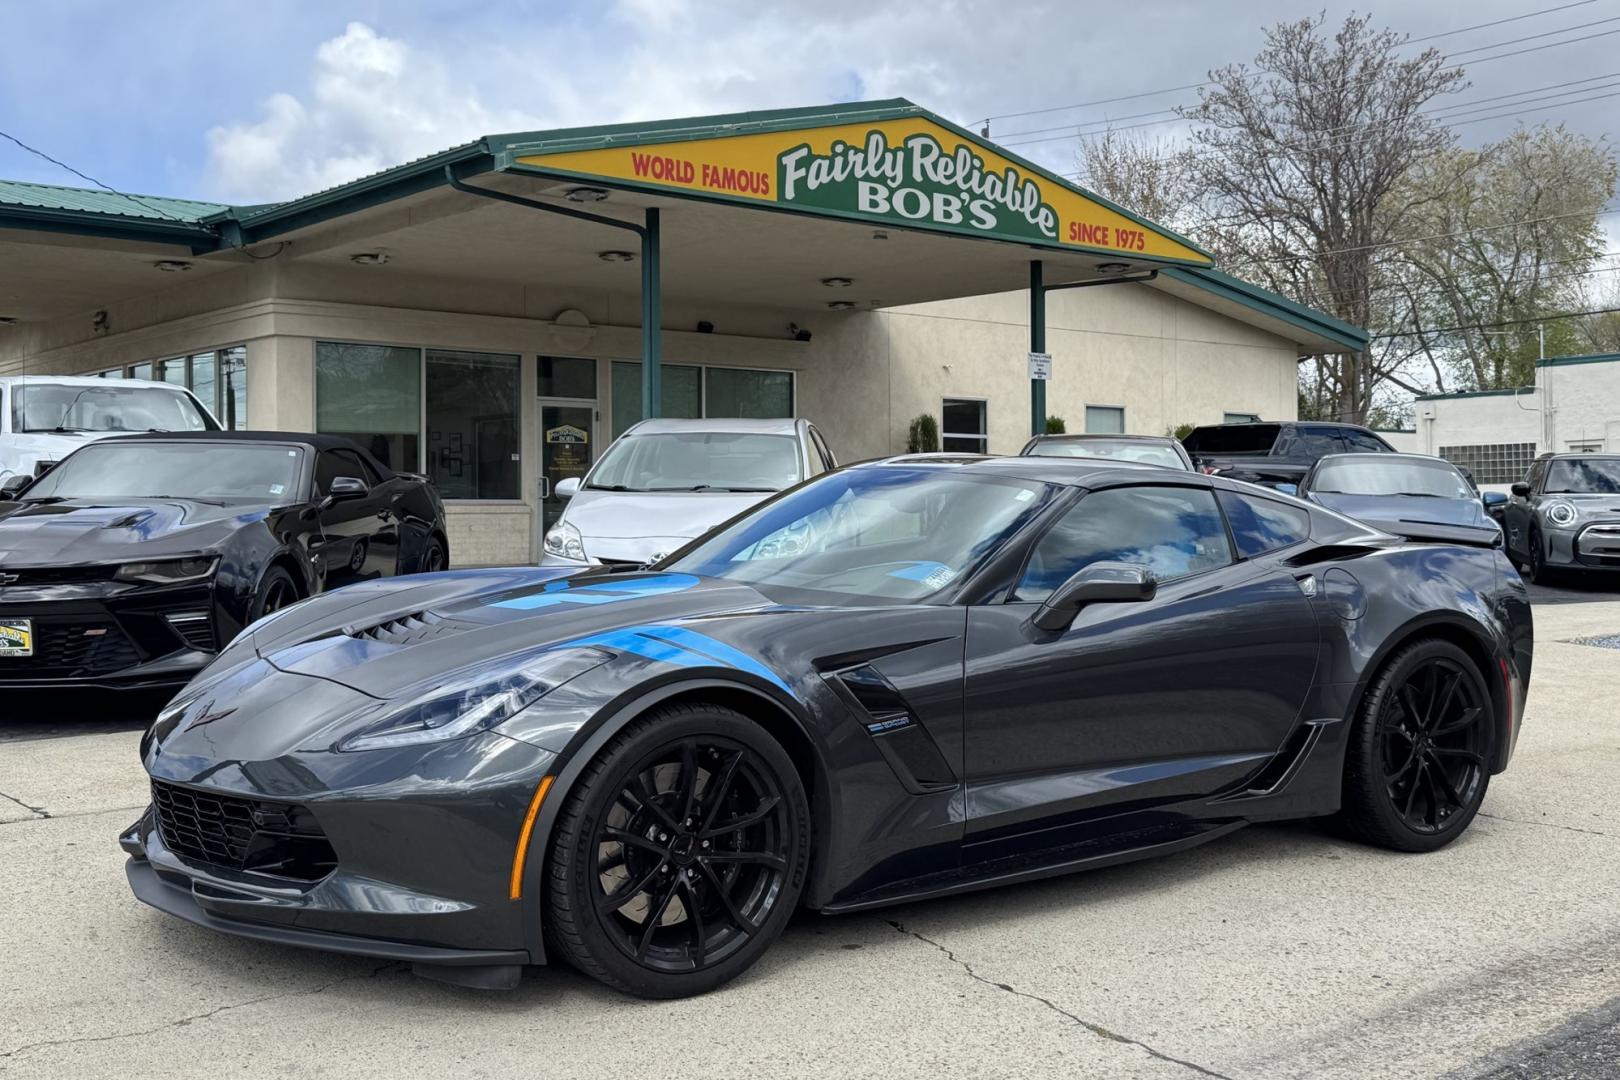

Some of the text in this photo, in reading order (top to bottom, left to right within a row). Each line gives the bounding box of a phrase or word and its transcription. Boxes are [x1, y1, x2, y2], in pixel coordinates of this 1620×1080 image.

[631, 152, 770, 196] WORLD FAMOUS
[782, 133, 1056, 237] Fairly Reliable
[858, 180, 997, 230] BOB'S
[1069, 221, 1145, 251] SINCE 1975
